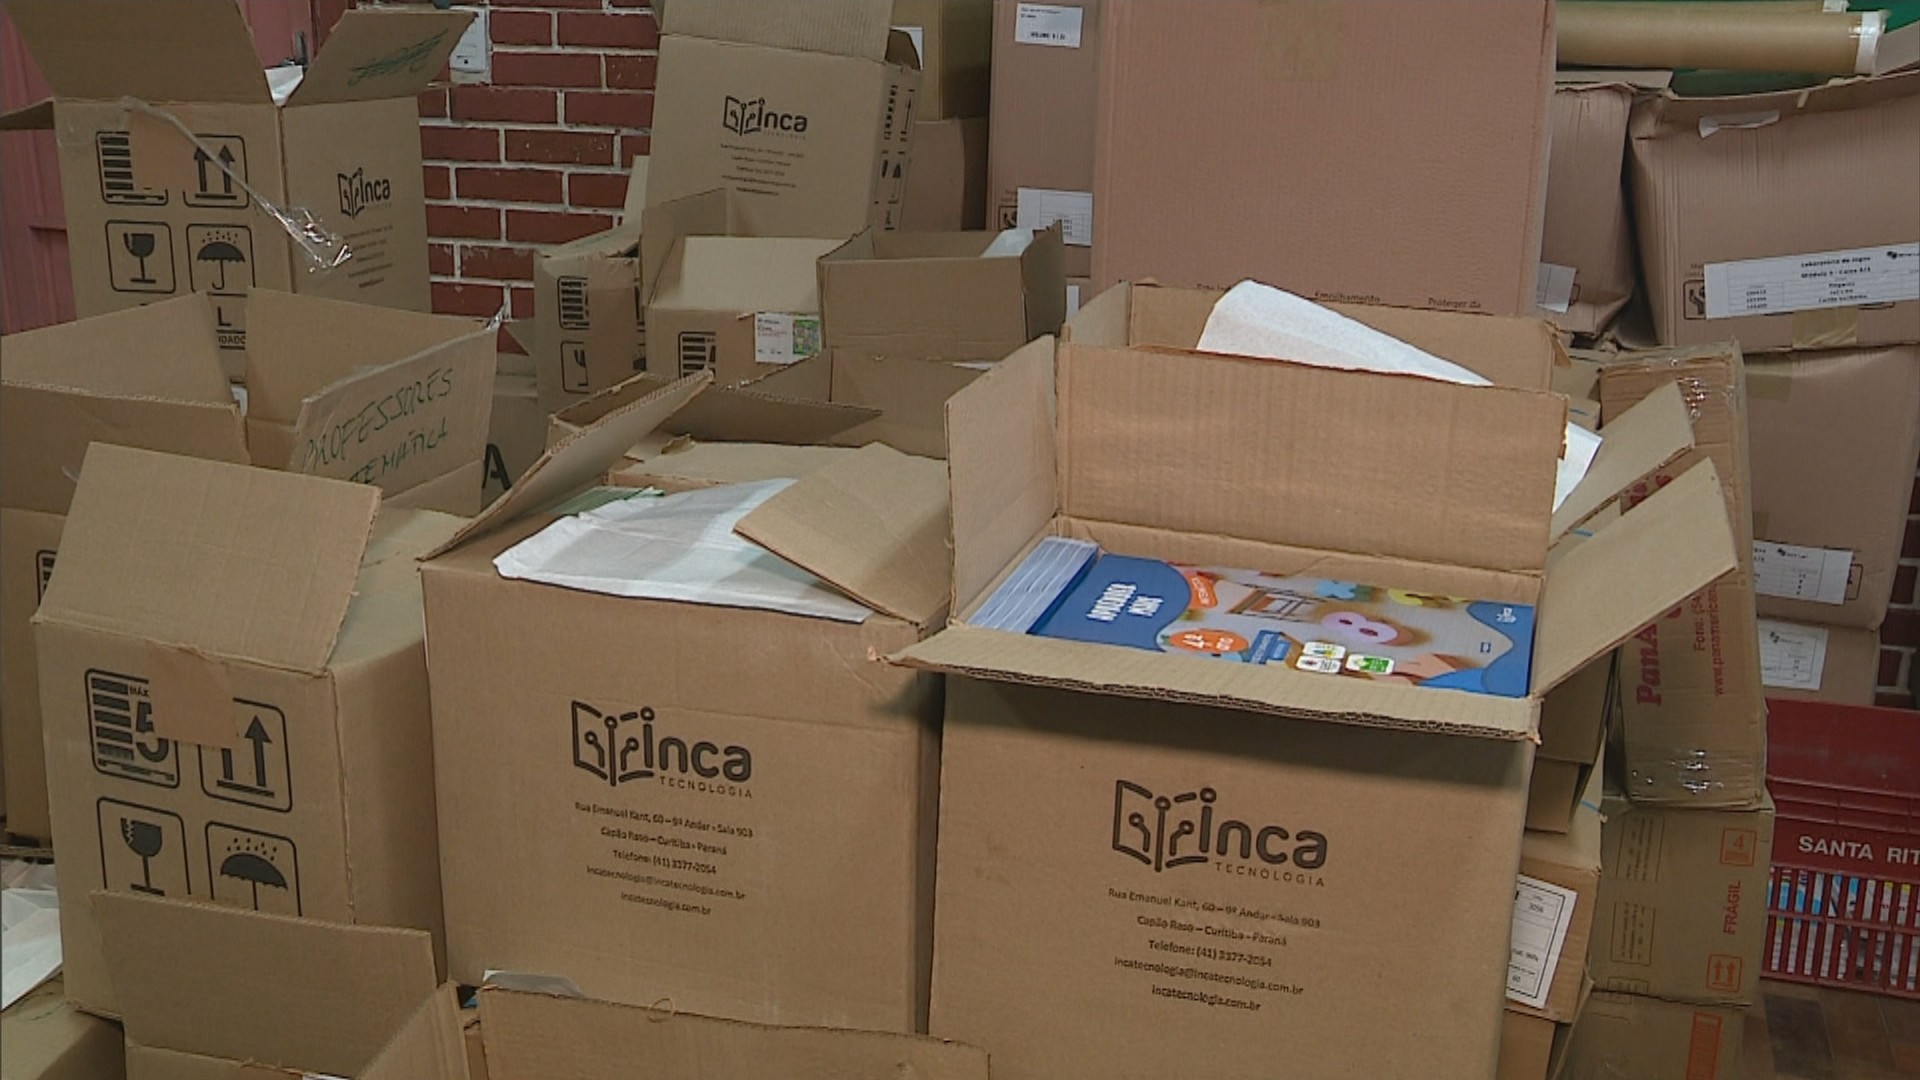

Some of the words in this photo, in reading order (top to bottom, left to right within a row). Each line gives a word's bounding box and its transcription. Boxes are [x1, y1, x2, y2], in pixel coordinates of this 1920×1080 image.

[659, 775, 753, 799] TECNOLOGIA
[575, 801, 591, 813] Rua
[592, 804, 629, 818] Emanuel
[684, 819, 711, 832] Andar
[717, 824, 735, 836] Sala
[736, 827, 753, 839] 903
[600, 826, 627, 840] Capão
[628, 831, 649, 843] Raso
[657, 836, 691, 851] Curitiba
[697, 841, 728, 855] Paraná
[1797, 835, 1874, 861] SANTA
[612, 849, 651, 863] Telefone:
[652, 855, 670, 869] (41)
[1213, 861, 1325, 888] TECNOLOGIA
[1108, 887, 1127, 900] Rua
[1128, 891, 1172, 907] Emanuel
[1173, 897, 1200, 912] Kant,
[1238, 906, 1270, 921] Andar
[1278, 913, 1299, 926] Sala
[1300, 917, 1321, 930] 903
[1722, 880, 1742, 936] FRÁGIL
[1136, 914, 1169, 930] Capão
[1169, 919, 1195, 934] Raso
[1204, 925, 1245, 941] Curitiba
[1252, 932, 1288, 947] Paraná
[1147, 939, 1195, 956] Telefone:
[1196, 945, 1218, 961] (41)
